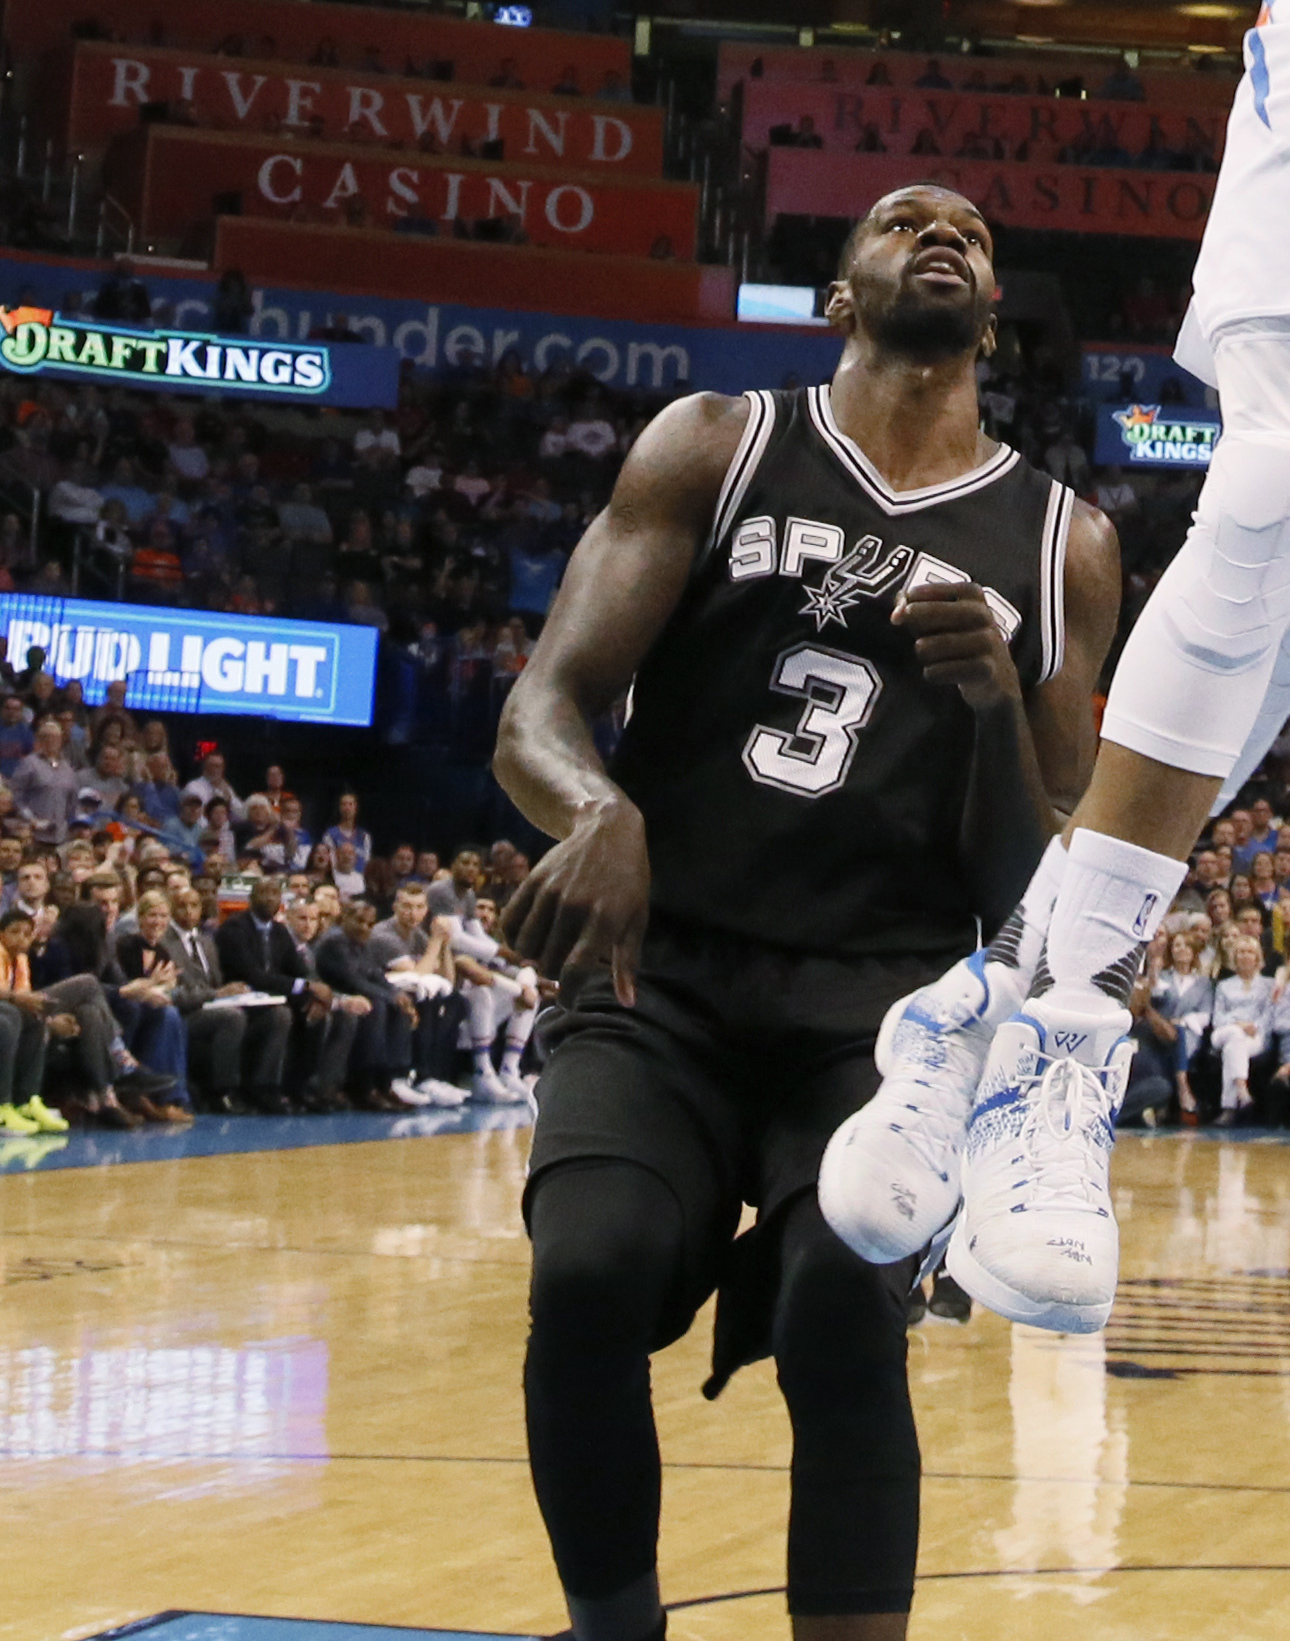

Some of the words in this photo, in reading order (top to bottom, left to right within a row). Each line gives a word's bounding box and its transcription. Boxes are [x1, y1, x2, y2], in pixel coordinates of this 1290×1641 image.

[107, 58, 634, 162] RIVERWIND
[257, 153, 595, 234] CASINO
[2, 321, 325, 389] DRAFTKINGS
[1126, 422, 1215, 444] DRAFT
[1135, 440, 1212, 461] KINGS
[146, 632, 328, 700] LIGHT
[741, 640, 884, 799] 3
